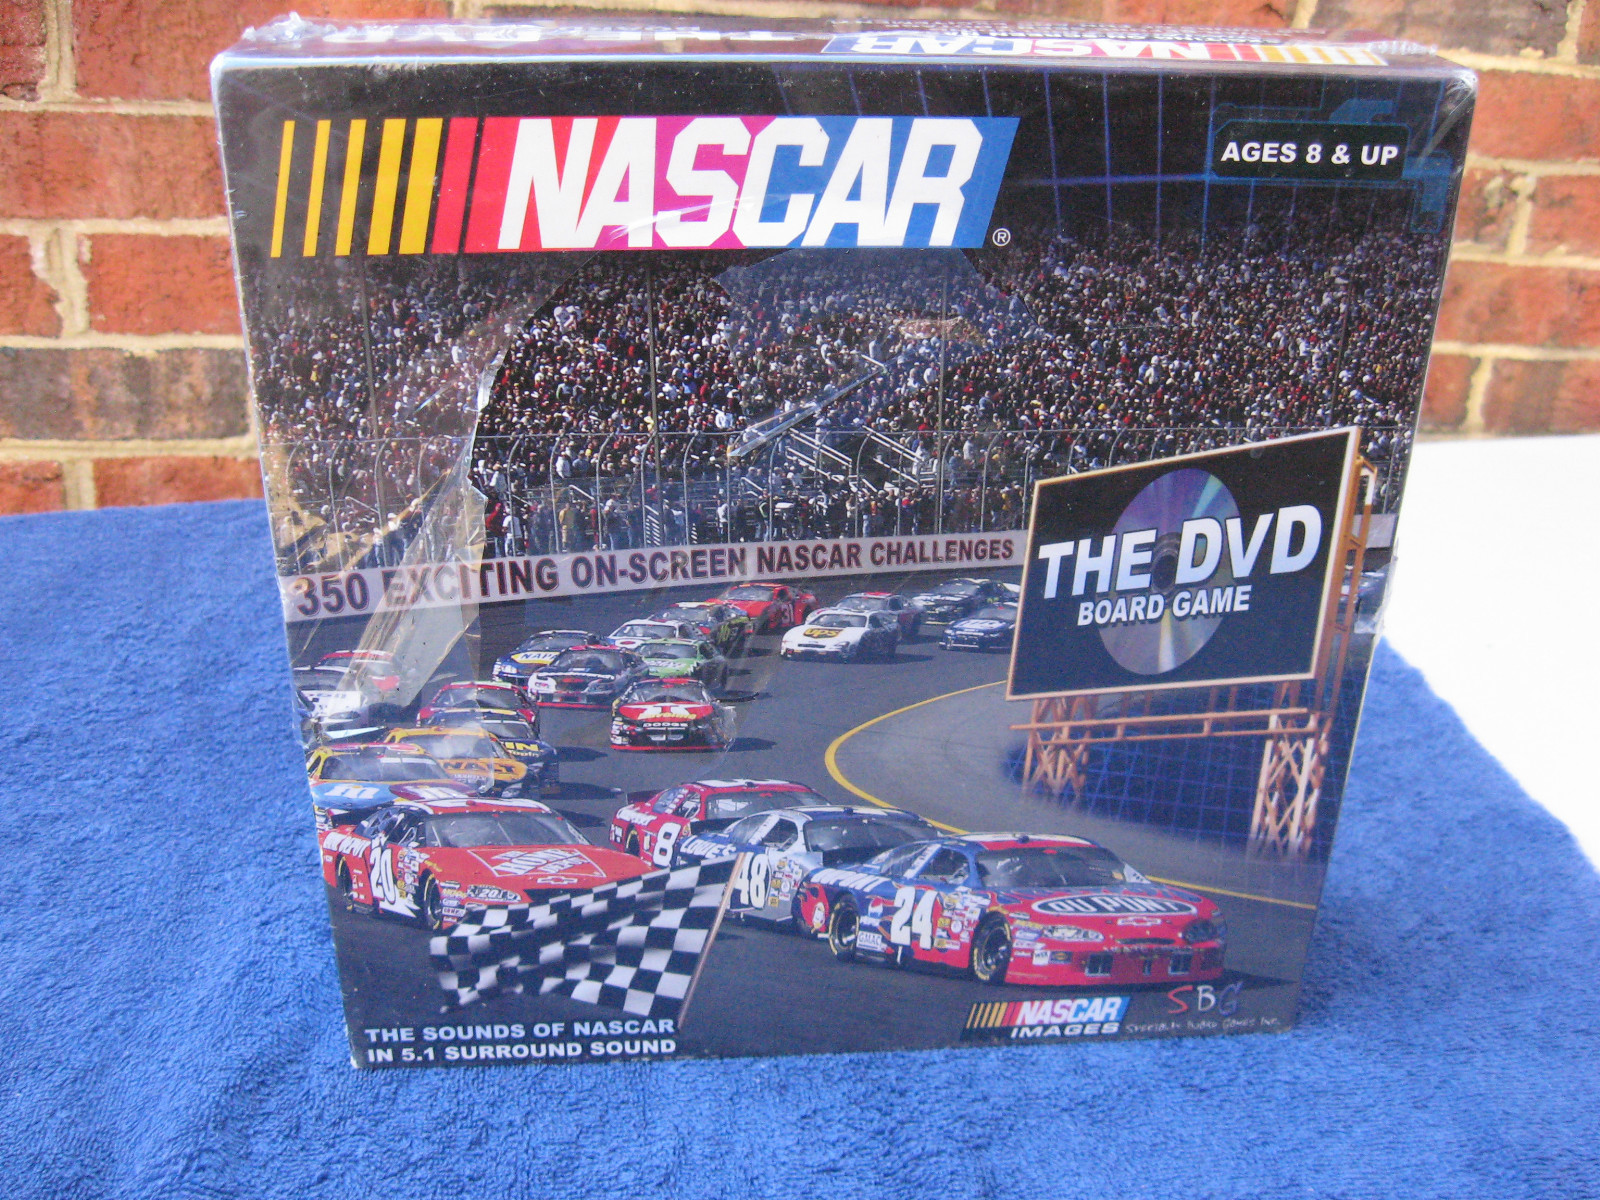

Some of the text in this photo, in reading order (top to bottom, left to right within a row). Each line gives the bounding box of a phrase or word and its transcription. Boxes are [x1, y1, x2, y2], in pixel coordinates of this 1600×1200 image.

[851, 35, 1211, 59] NASCAR
[1221, 142, 1399, 167] AGES 8 & UP
[497, 115, 983, 250] NASCAR
[1037, 505, 1322, 600] THE DVD
[296, 538, 1014, 617] 350 EXCITING ON-SCREEN NASCAR CHALLENGES
[1077, 585, 1252, 626] BOARD GAME
[653, 822, 682, 867] 8
[370, 846, 396, 905] 20
[734, 852, 768, 909] 48
[891, 885, 940, 950] 24
[859, 932, 882, 946] GMAC
[365, 1019, 675, 1044] THE SOUNDS OF NASCAR
[1011, 1022, 1120, 1039] IMAGES
[1017, 997, 1123, 1025] NASCAR
[367, 1039, 677, 1063] IN 5.1 SURROUND SOUND
